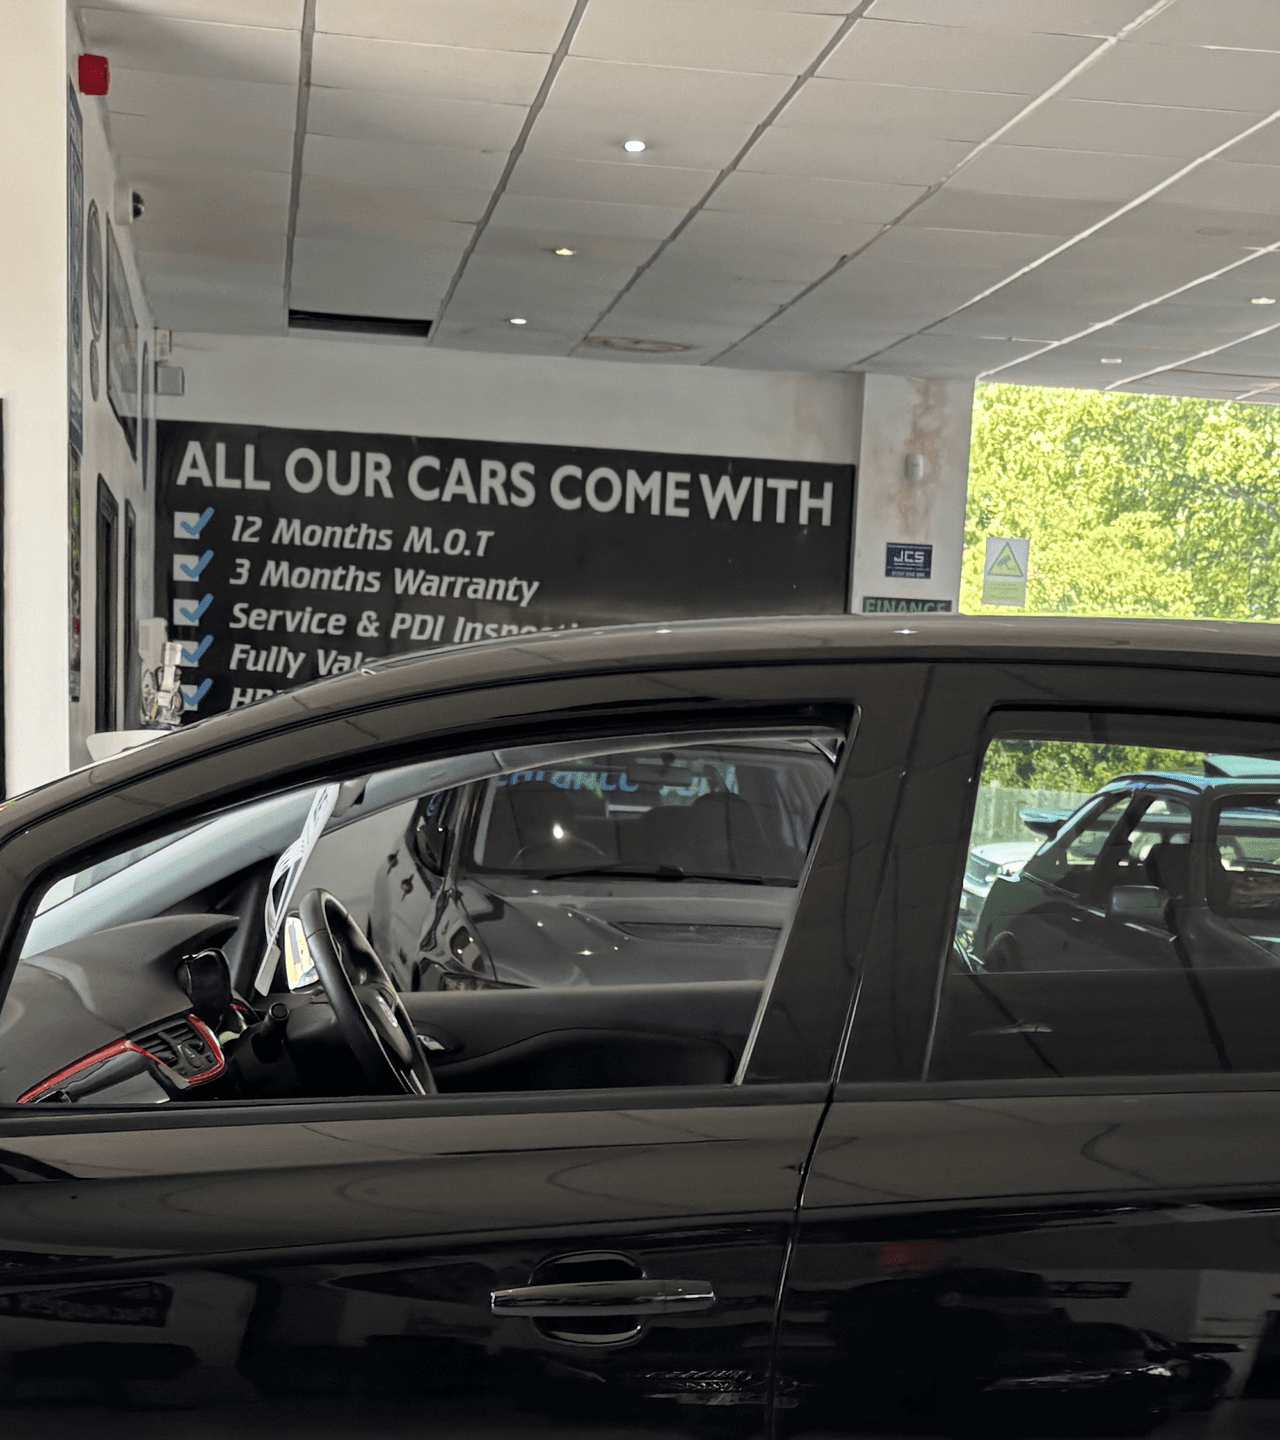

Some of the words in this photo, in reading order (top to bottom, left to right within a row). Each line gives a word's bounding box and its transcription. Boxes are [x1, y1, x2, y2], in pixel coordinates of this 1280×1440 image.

[176, 440, 270, 490] ALL
[285, 447, 394, 499] OUR
[407, 455, 536, 507] CARS
[550, 464, 691, 517] COME
[699, 473, 833, 526] WITH
[231, 515, 263, 543] 12
[271, 517, 393, 551] Months
[403, 526, 494, 557] M.O.T
[893, 549, 925, 563] JCS
[229, 558, 251, 585] 3
[260, 560, 381, 593] Months
[394, 567, 540, 607] Warranty
[229, 602, 347, 636] Service
[356, 610, 380, 638] &
[390, 612, 445, 643] PDI
[229, 644, 306, 679] Fully
[317, 649, 377, 676] Val
